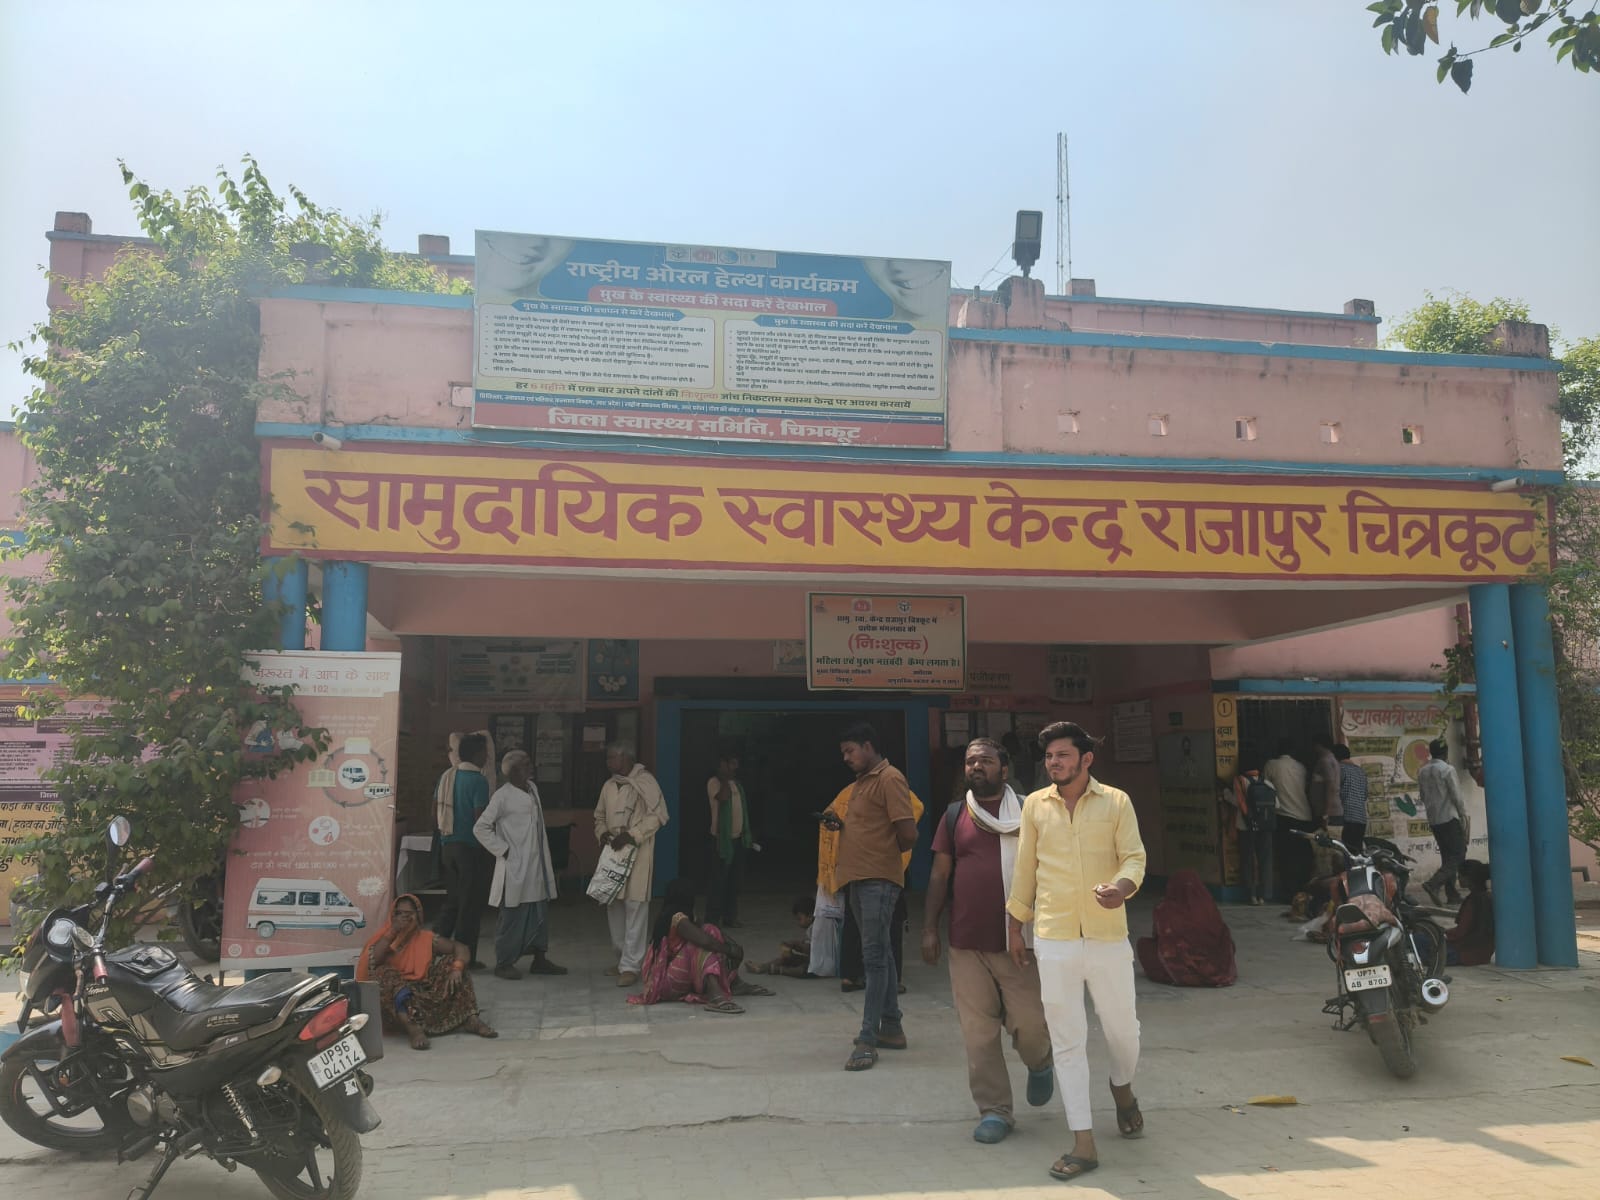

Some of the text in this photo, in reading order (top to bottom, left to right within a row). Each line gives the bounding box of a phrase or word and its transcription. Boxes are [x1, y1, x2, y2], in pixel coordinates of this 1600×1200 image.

[566, 260, 859, 295] राष्ट्रीय ओरल हेल्थ कार्यक्रम
[600, 288, 625, 302] मुख
[629, 288, 643, 302] के
[699, 291, 718, 305] की
[722, 295, 747, 307] सदा
[752, 295, 773, 310] करें
[775, 298, 827, 313] देखभाल
[516, 381, 528, 389] हर
[567, 383, 577, 391] में
[578, 385, 595, 393] एक
[616, 386, 640, 395] अपने
[642, 387, 664, 397] दांतों
[666, 388, 678, 397] की
[742, 393, 781, 403] निकटतम
[814, 395, 833, 406] केन्द्र
[836, 398, 848, 406] पर
[548, 407, 608, 427] जिला
[613, 415, 694, 432] स्वास्थ्य
[781, 419, 862, 443] चित्रकूट
[304, 461, 1537, 572] सामुदायिक स्वास्थ्य केन्द्र राजापुर चित्रकूट
[298, 665, 309, 679] में
[316, 670, 340, 680] आप
[344, 667, 359, 680] के
[816, 656, 840, 665] महिला
[313, 684, 328, 693] 102
[1357, 969, 1377, 978] UP71
[319, 1041, 350, 1066] UP96
